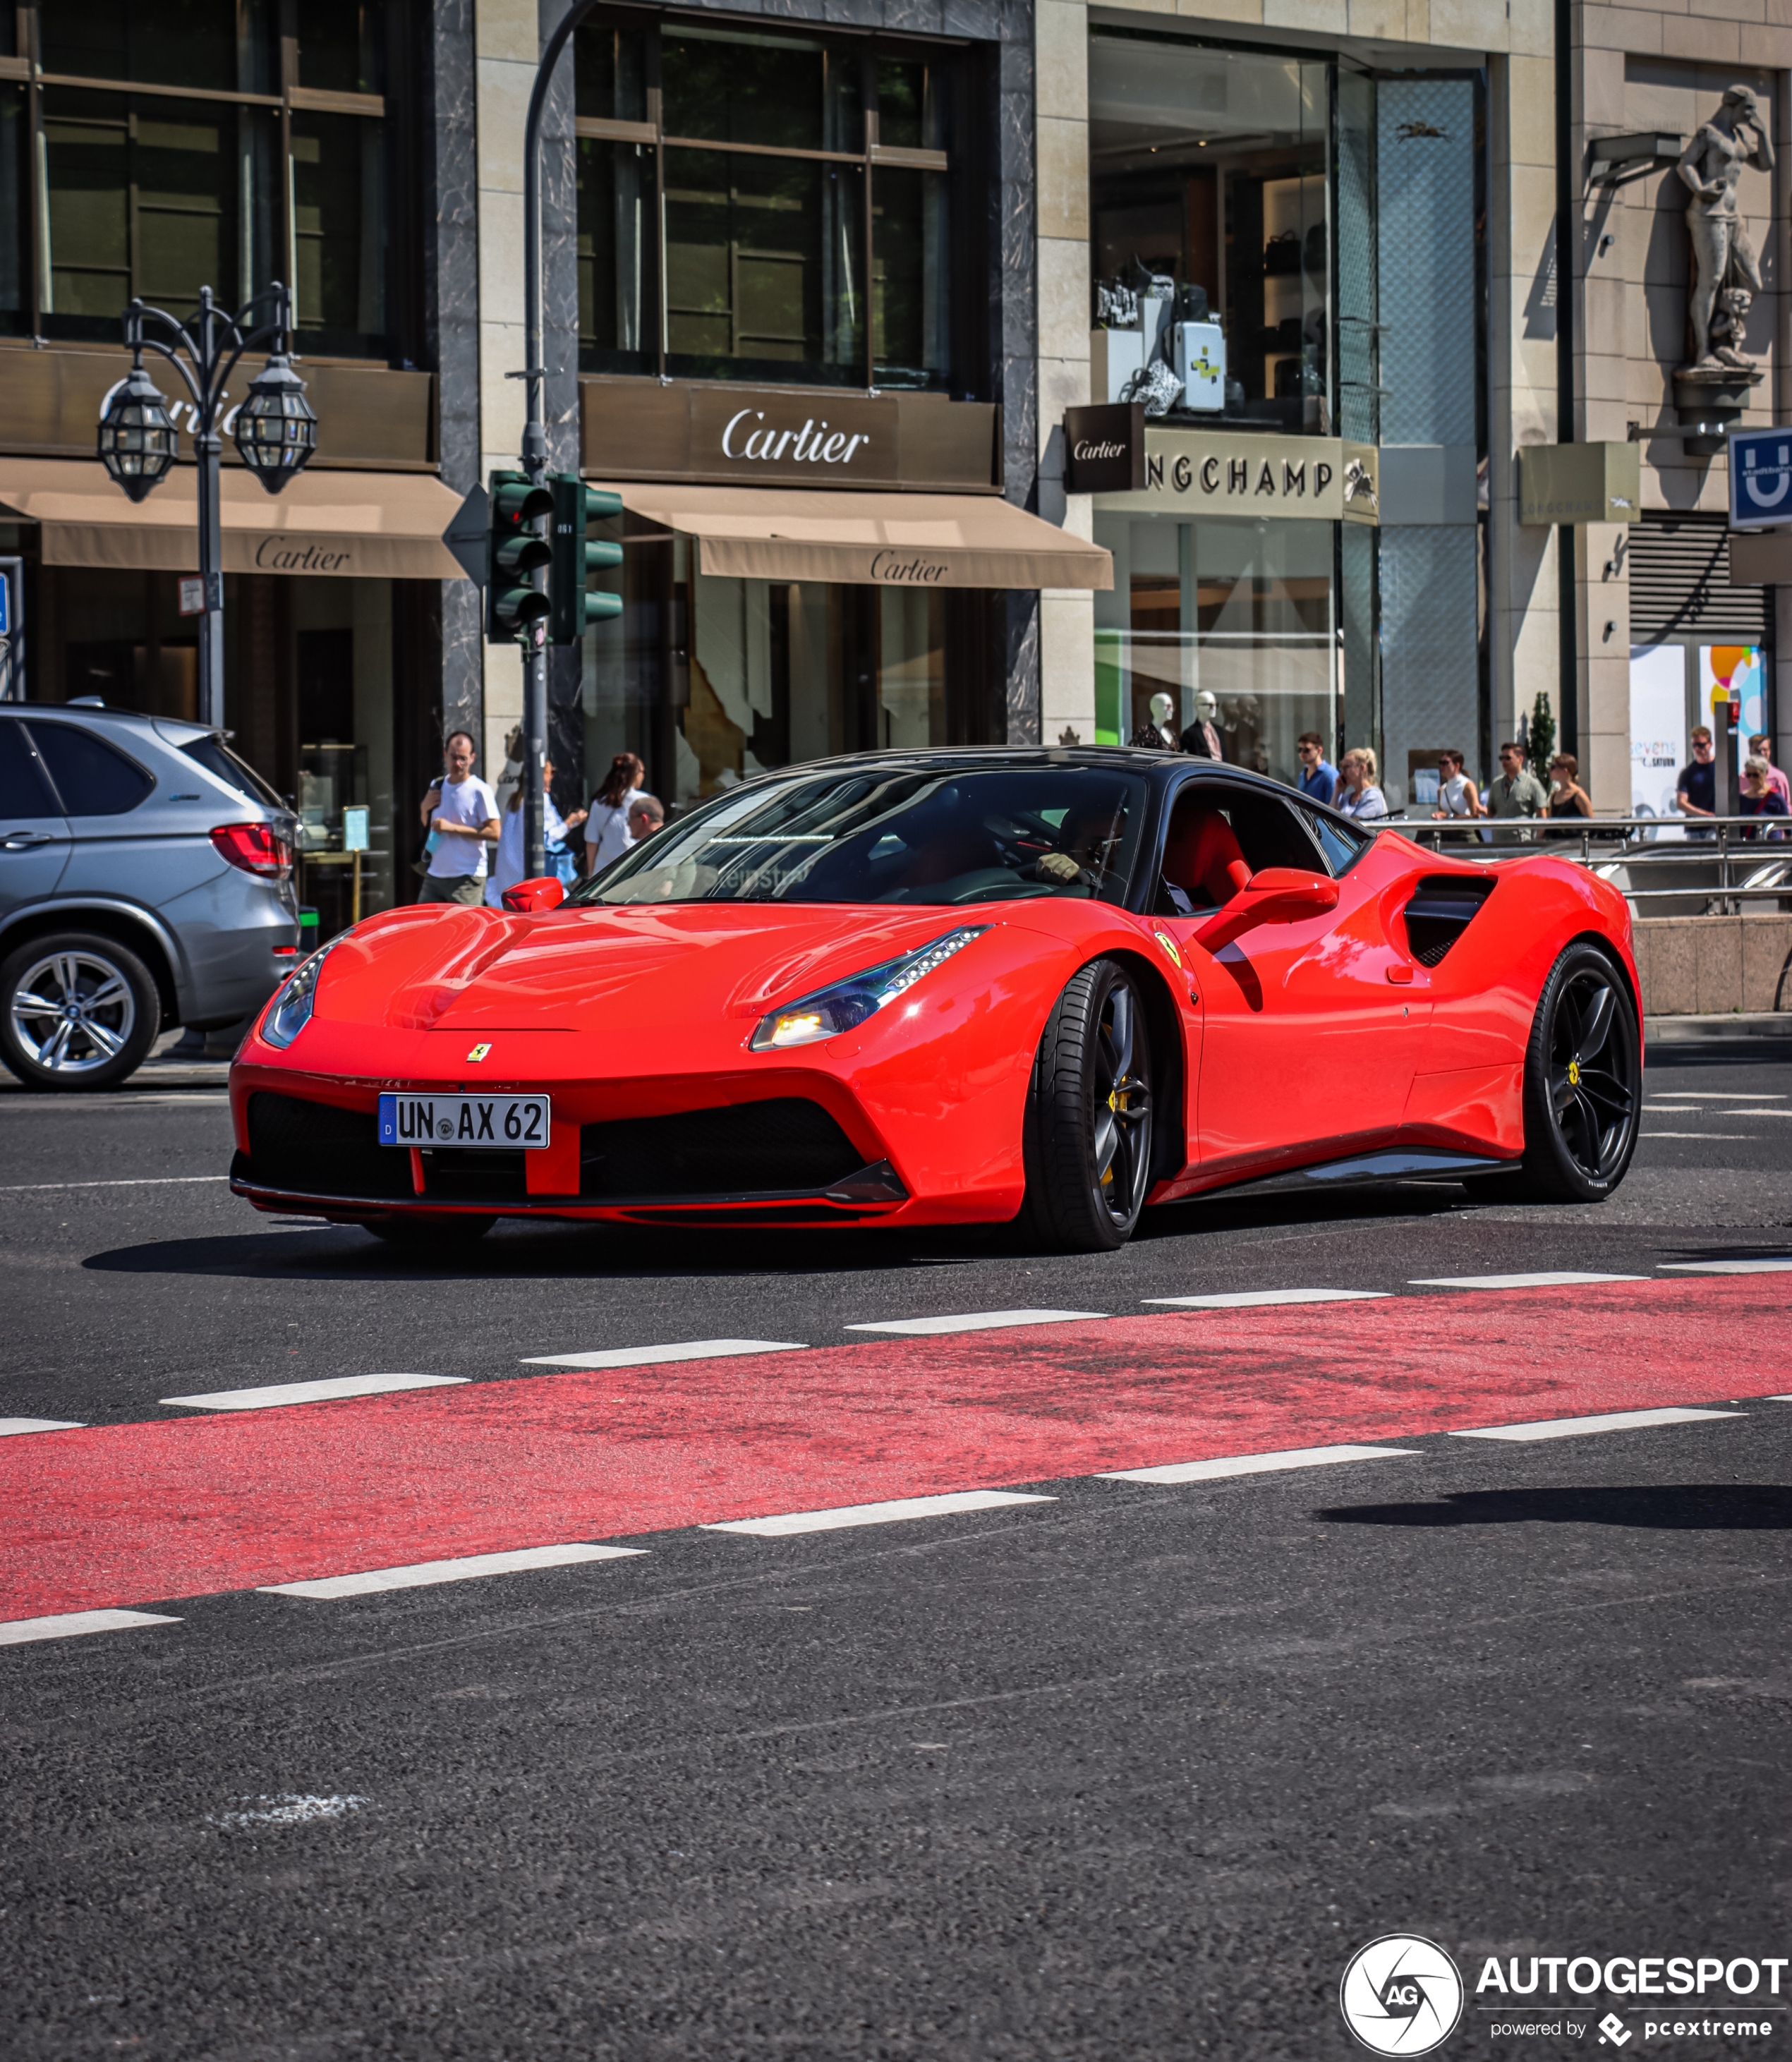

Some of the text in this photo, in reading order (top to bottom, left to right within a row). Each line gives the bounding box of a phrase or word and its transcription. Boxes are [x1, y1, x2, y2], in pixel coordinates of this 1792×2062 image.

[722, 408, 870, 463] Cartier
[1074, 439, 1126, 461] Cartier
[1144, 452, 1333, 497] NGCHAMP
[255, 534, 351, 571] Cartier
[870, 548, 948, 582] Cartier
[1652, 757, 1676, 768] SATURN
[385, 1124, 392, 1135] D
[399, 1101, 542, 1141] UN AX 62
